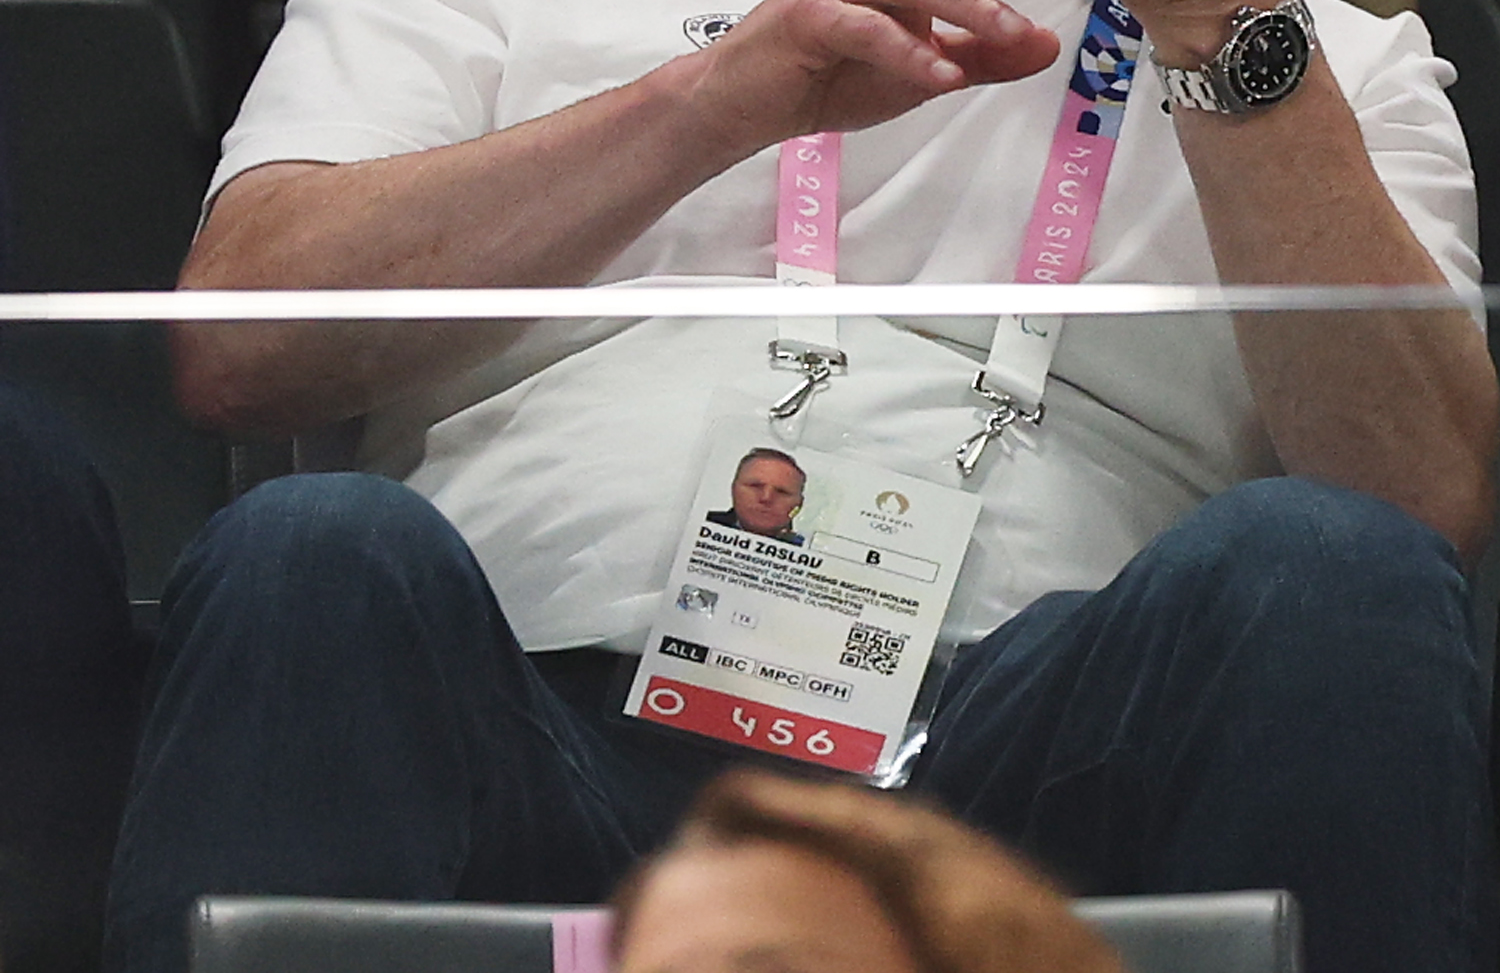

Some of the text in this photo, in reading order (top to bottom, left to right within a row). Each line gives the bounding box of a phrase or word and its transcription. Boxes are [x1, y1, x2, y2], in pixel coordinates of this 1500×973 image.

[793, 173, 821, 257] 2024
[1033, 146, 1092, 284] ARIS 2024
[699, 526, 823, 569] David ZASLAV
[866, 549, 881, 565] B
[665, 641, 700, 660] ALL
[715, 654, 748, 671] IBC
[758, 666, 800, 686] MPC
[808, 679, 848, 698] OFH
